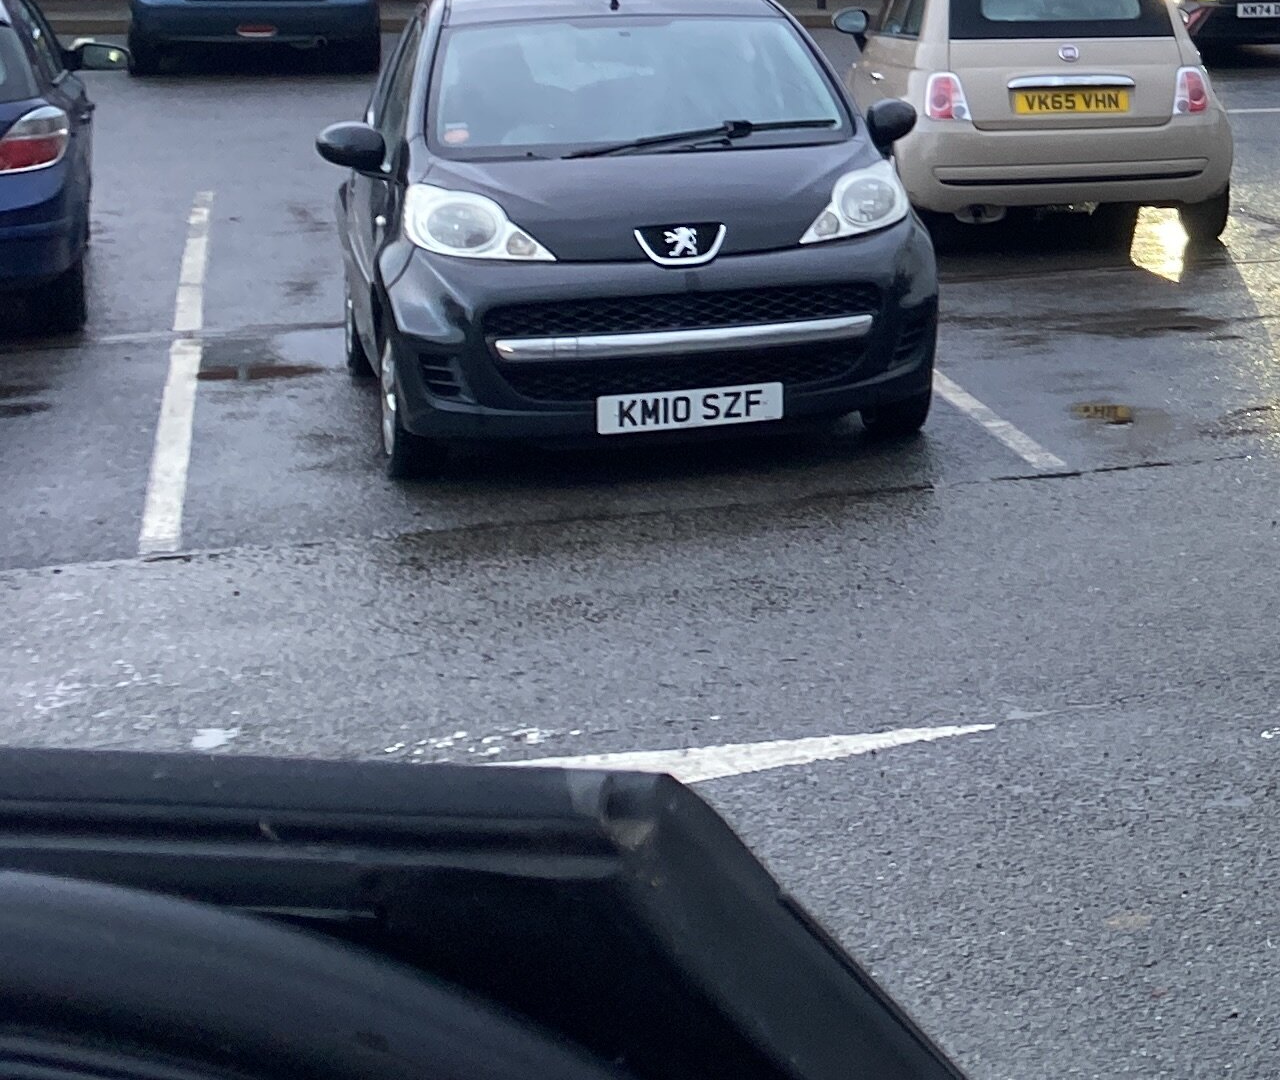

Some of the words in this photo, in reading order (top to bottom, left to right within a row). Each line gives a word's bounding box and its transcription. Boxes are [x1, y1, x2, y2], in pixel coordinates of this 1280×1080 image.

[1024, 93, 1077, 110] VK65
[1080, 91, 1120, 109] VHN
[617, 396, 691, 428] KM10
[702, 389, 763, 421] SZF
